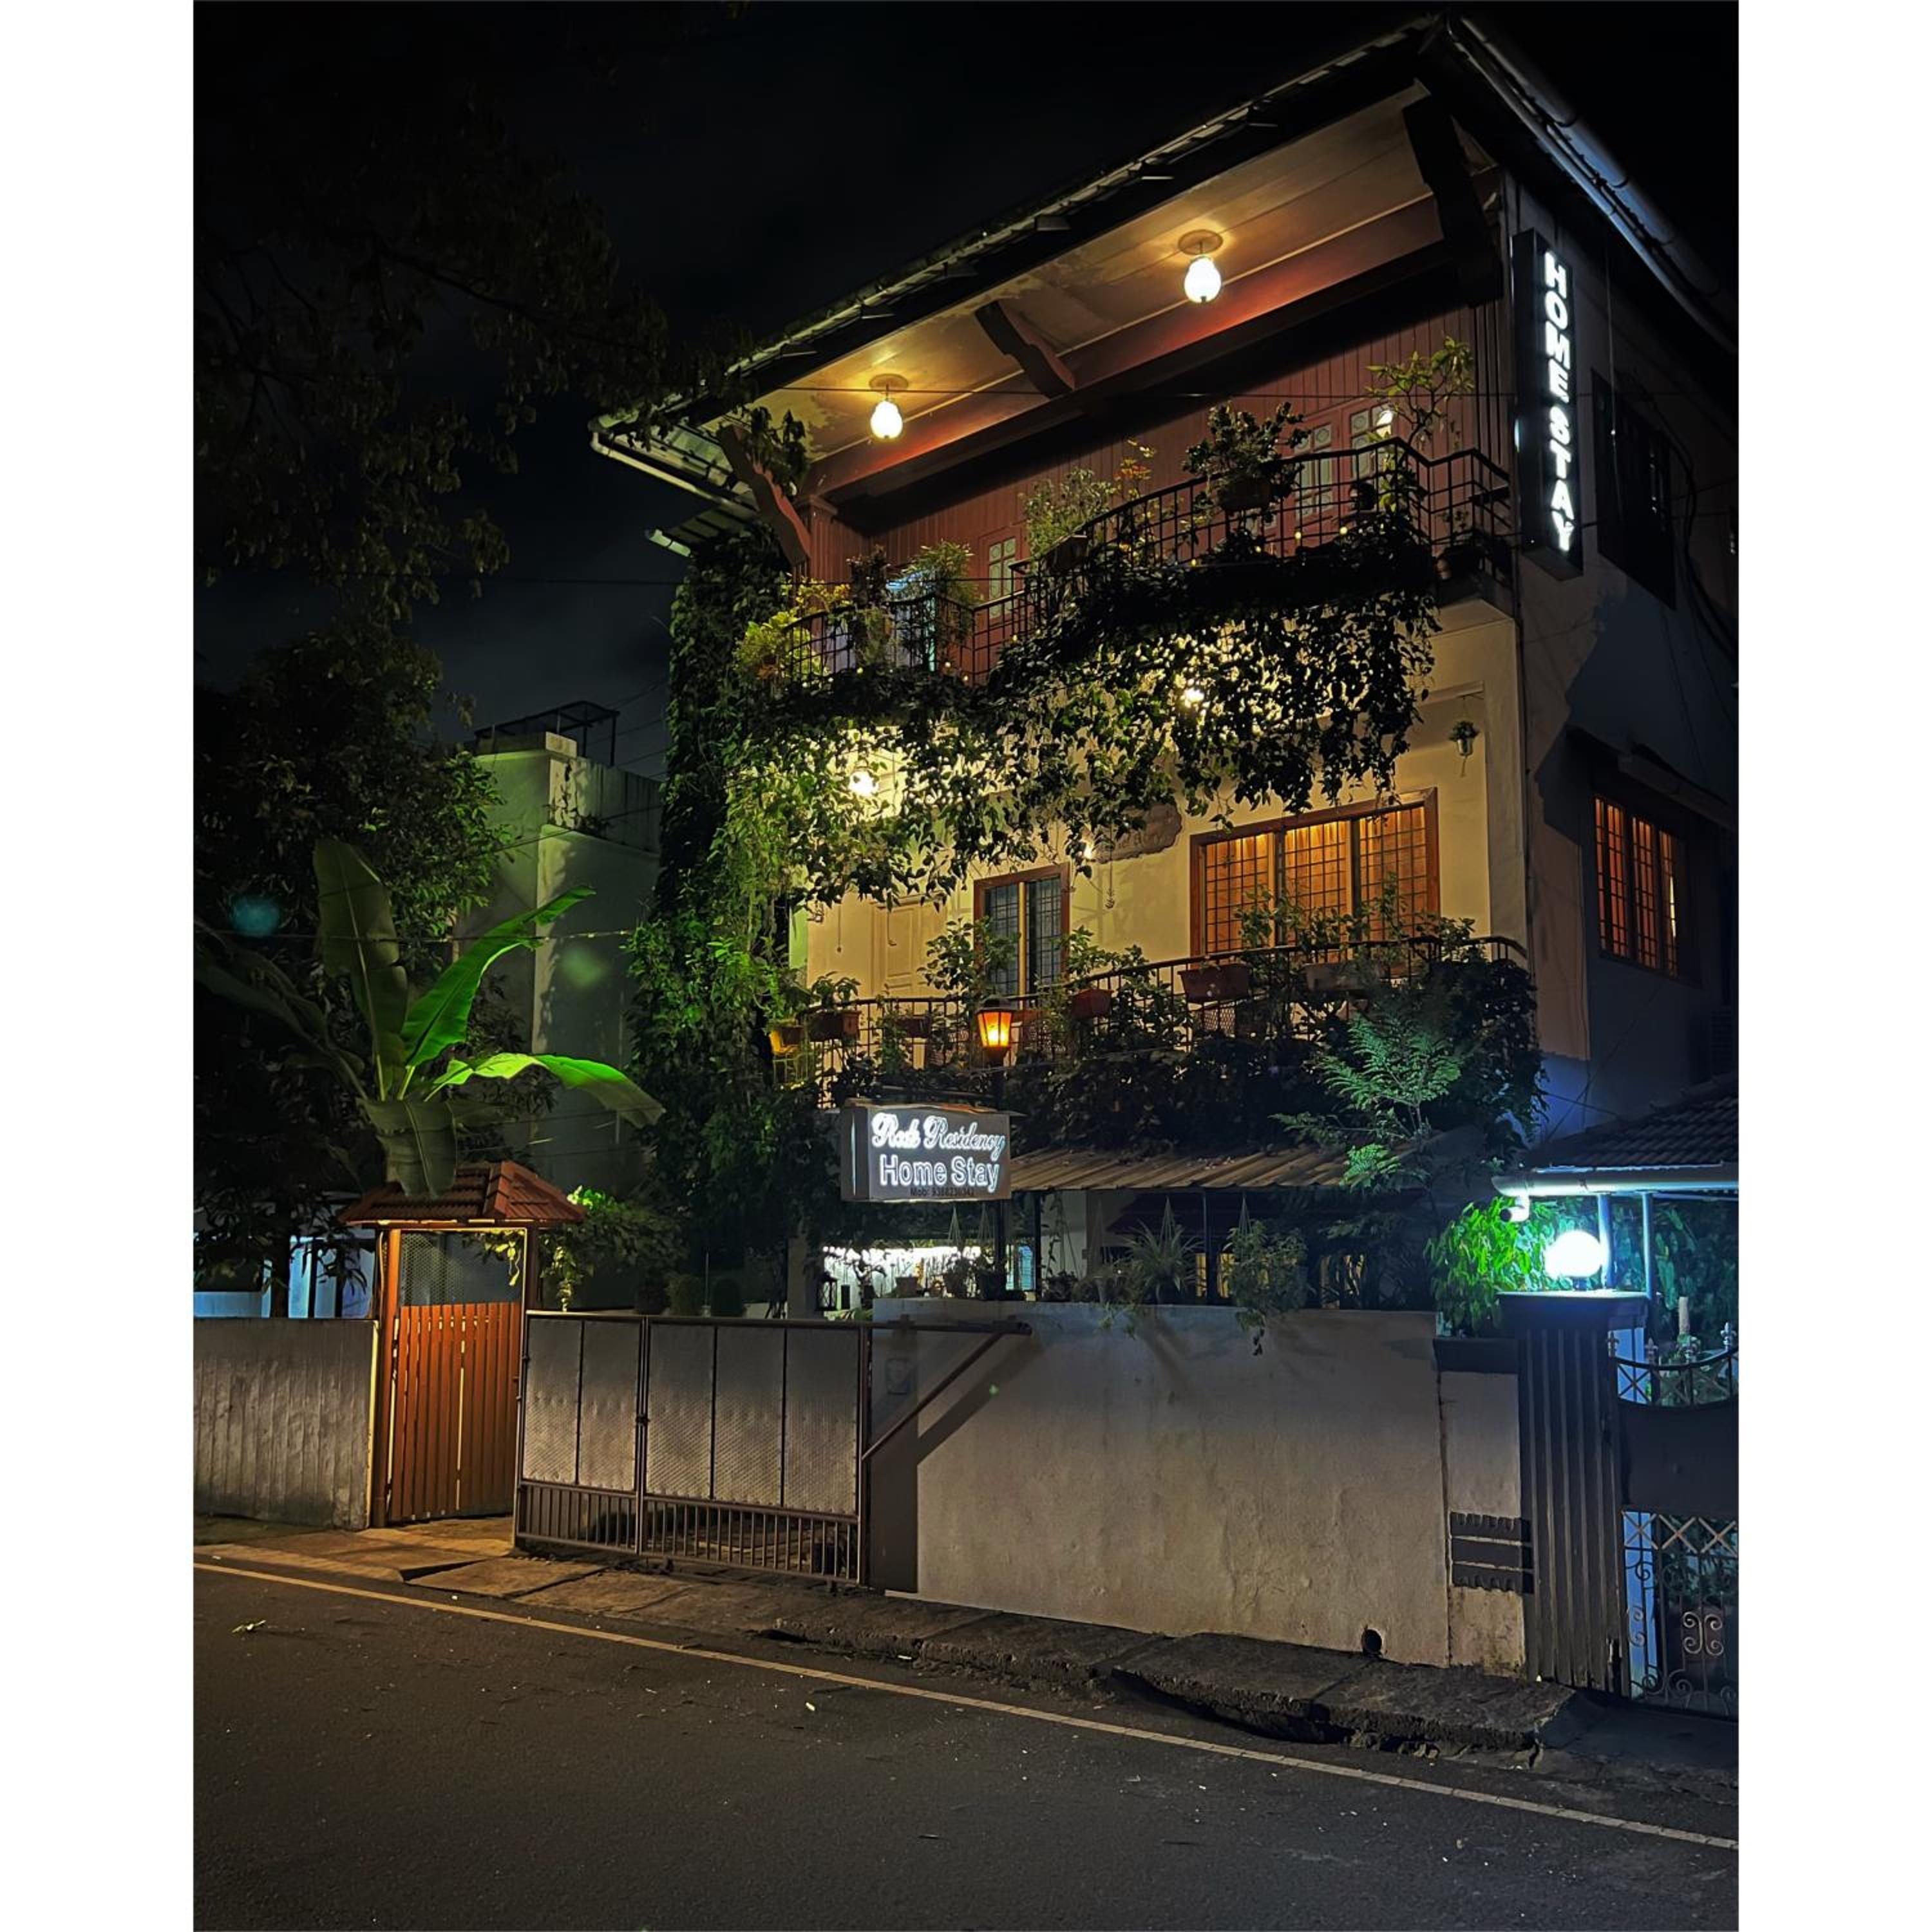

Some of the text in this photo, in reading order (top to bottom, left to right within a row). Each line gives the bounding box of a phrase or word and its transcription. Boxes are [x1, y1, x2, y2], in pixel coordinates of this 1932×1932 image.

[1545, 251, 1575, 552] HOME STAY
[923, 1115, 1006, 1161] Residency
[879, 1154, 999, 1193] Home Stay
